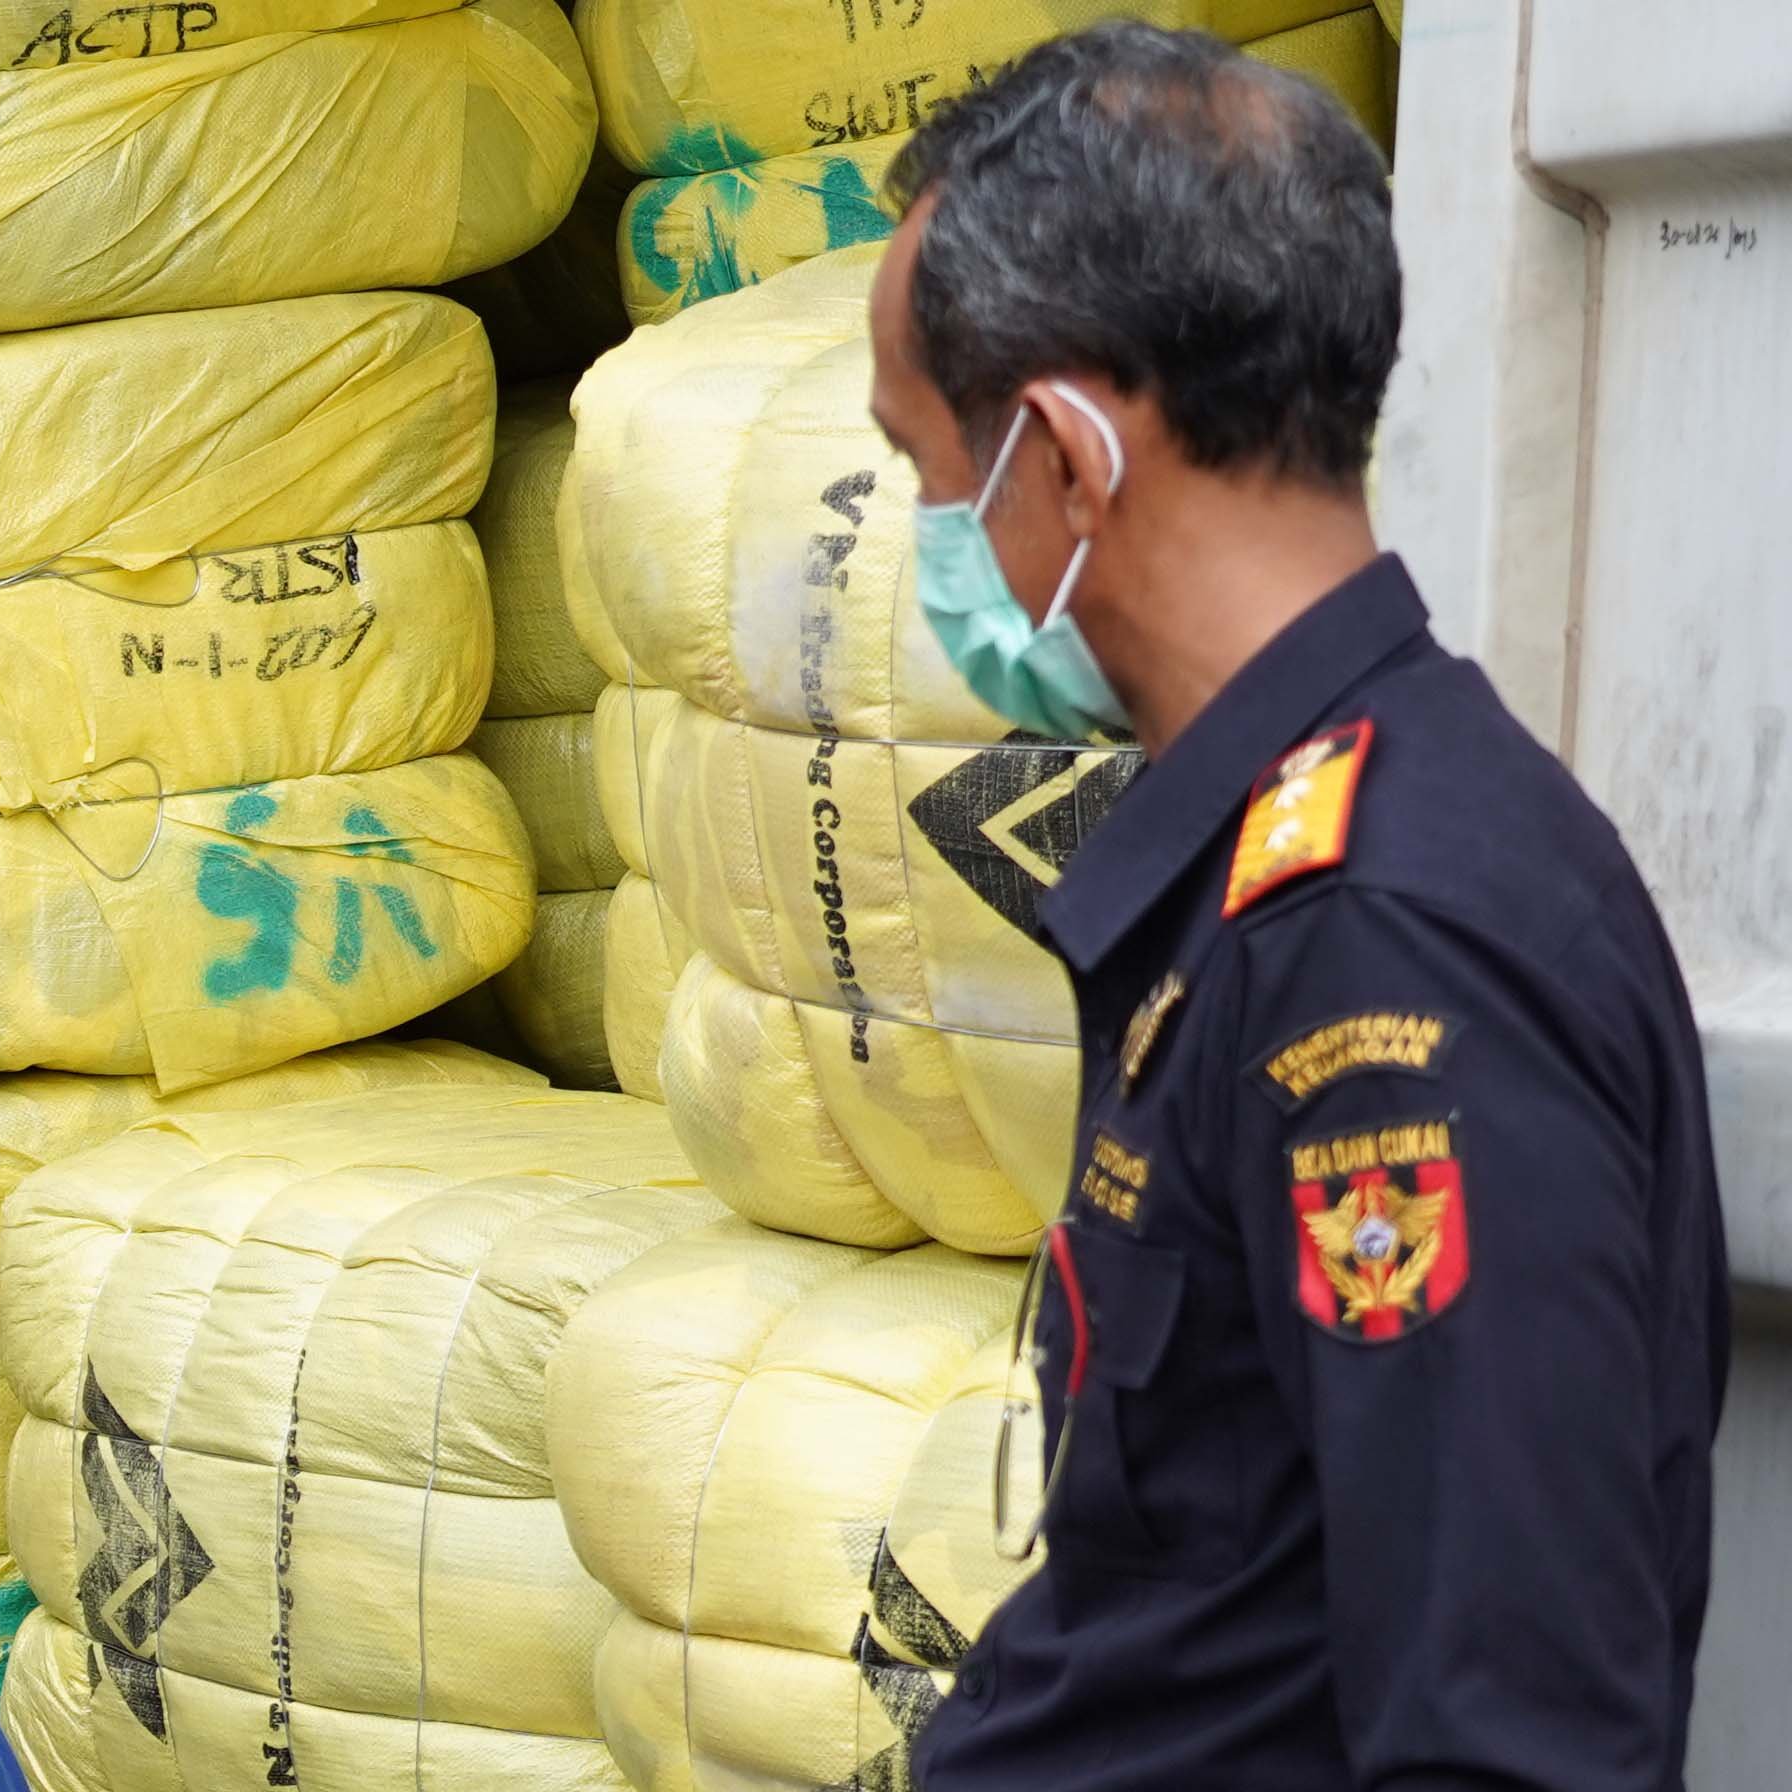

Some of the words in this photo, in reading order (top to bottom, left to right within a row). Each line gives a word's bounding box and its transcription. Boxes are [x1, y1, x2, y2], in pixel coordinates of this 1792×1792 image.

[800, 605, 840, 791] Trading
[1266, 1012, 1444, 1084] KEMENTERIAN
[1285, 1036, 1431, 1098] KEUANGAN
[1292, 1143, 1335, 1181] BEA
[1331, 1133, 1381, 1175] DAN
[1377, 1119, 1452, 1167] CUKAI
